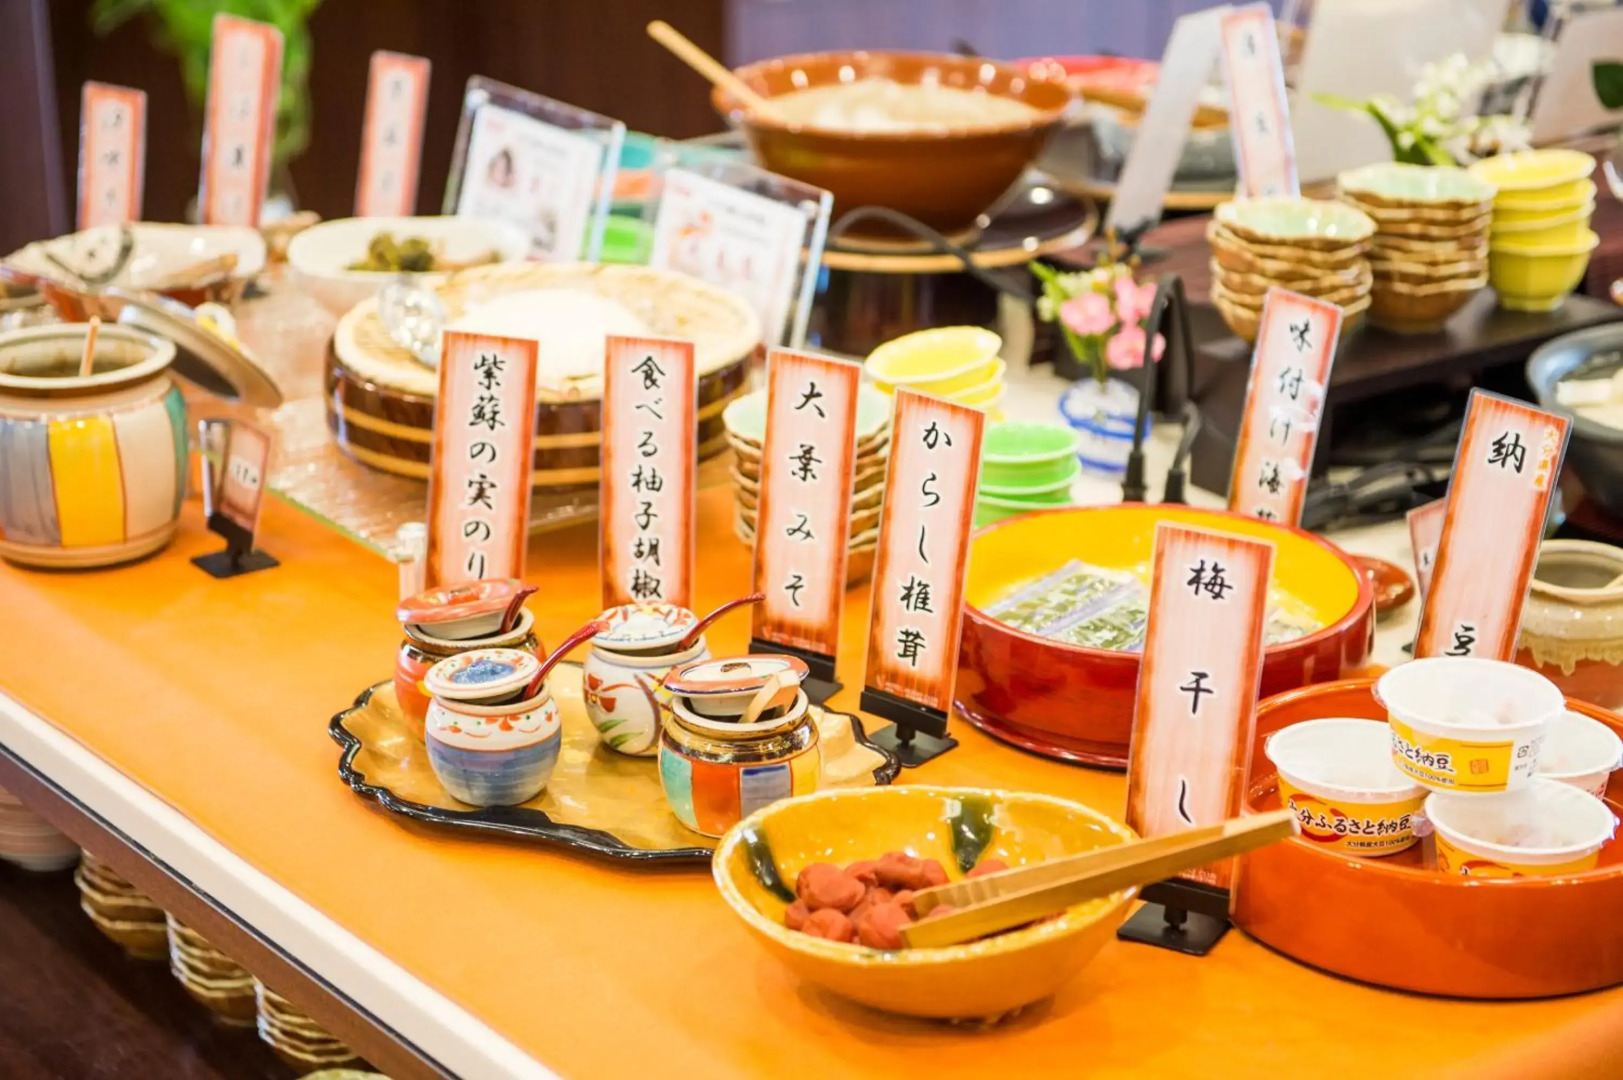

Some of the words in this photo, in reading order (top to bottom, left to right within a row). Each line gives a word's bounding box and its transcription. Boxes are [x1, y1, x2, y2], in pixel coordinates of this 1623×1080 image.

[465, 353, 507, 580] 紫蘇の実のり
[631, 355, 666, 600] 食べる柚子胡椒
[784, 381, 826, 606] 大葉みそ
[1256, 318, 1312, 518] 味付け海
[896, 421, 952, 667] からし椎茸
[1445, 431, 1526, 657] 納豆
[1178, 559, 1234, 825] 梅干し
